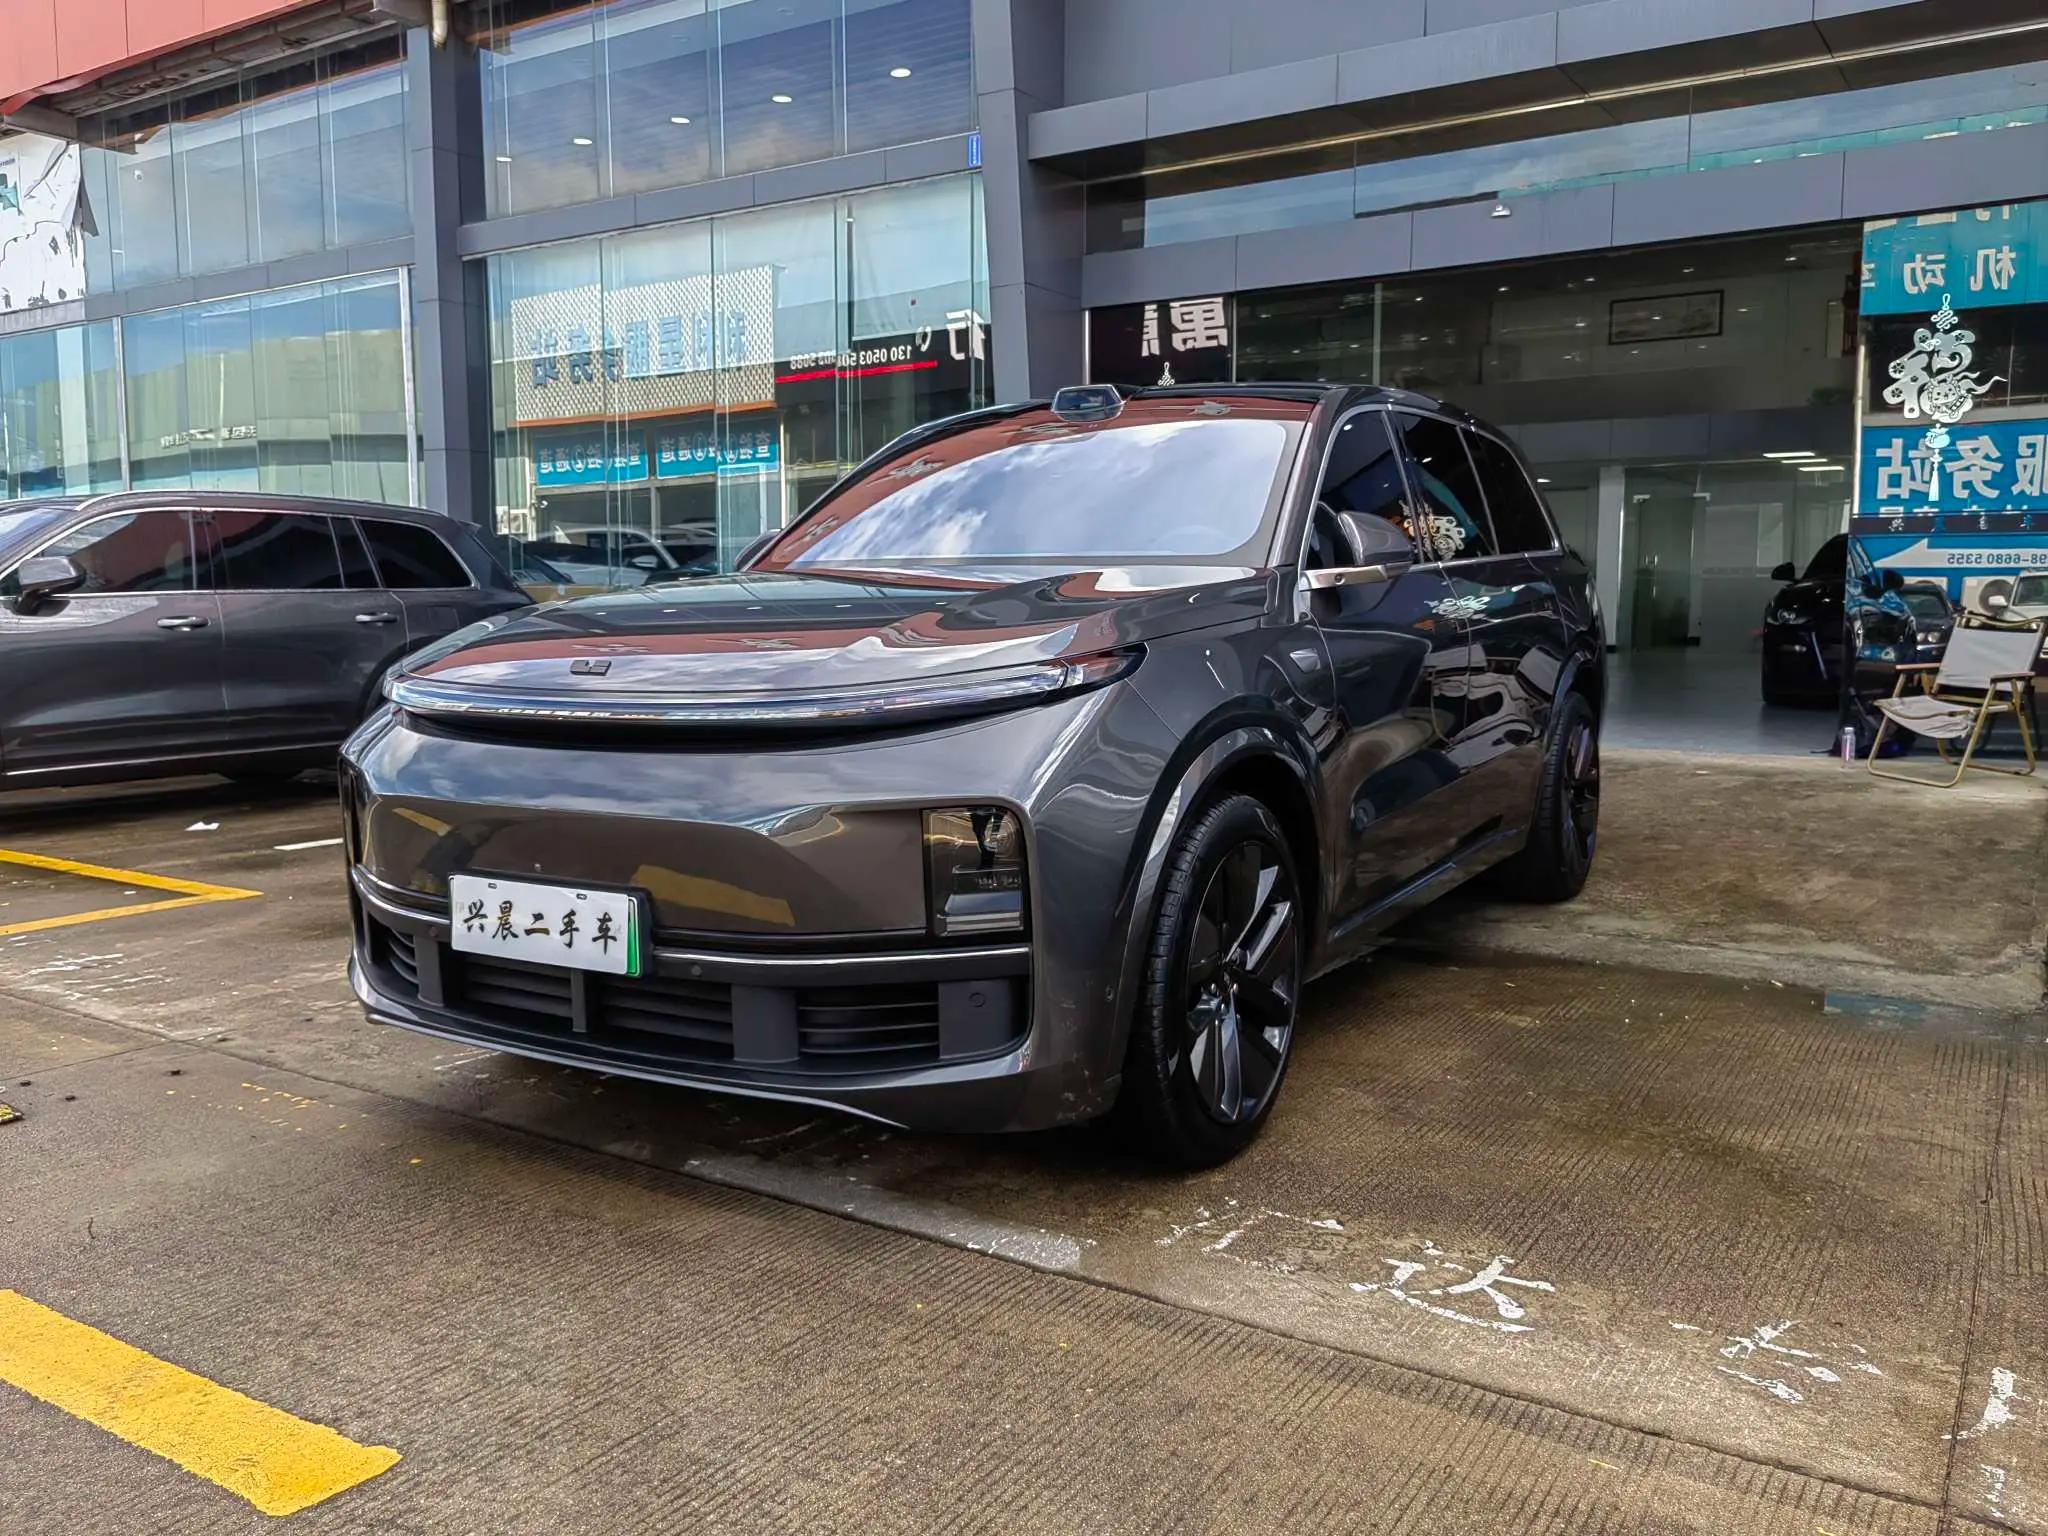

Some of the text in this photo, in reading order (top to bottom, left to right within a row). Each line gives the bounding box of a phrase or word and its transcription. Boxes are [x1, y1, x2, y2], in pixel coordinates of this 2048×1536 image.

[463, 899, 618, 955] 兴晨二手车
